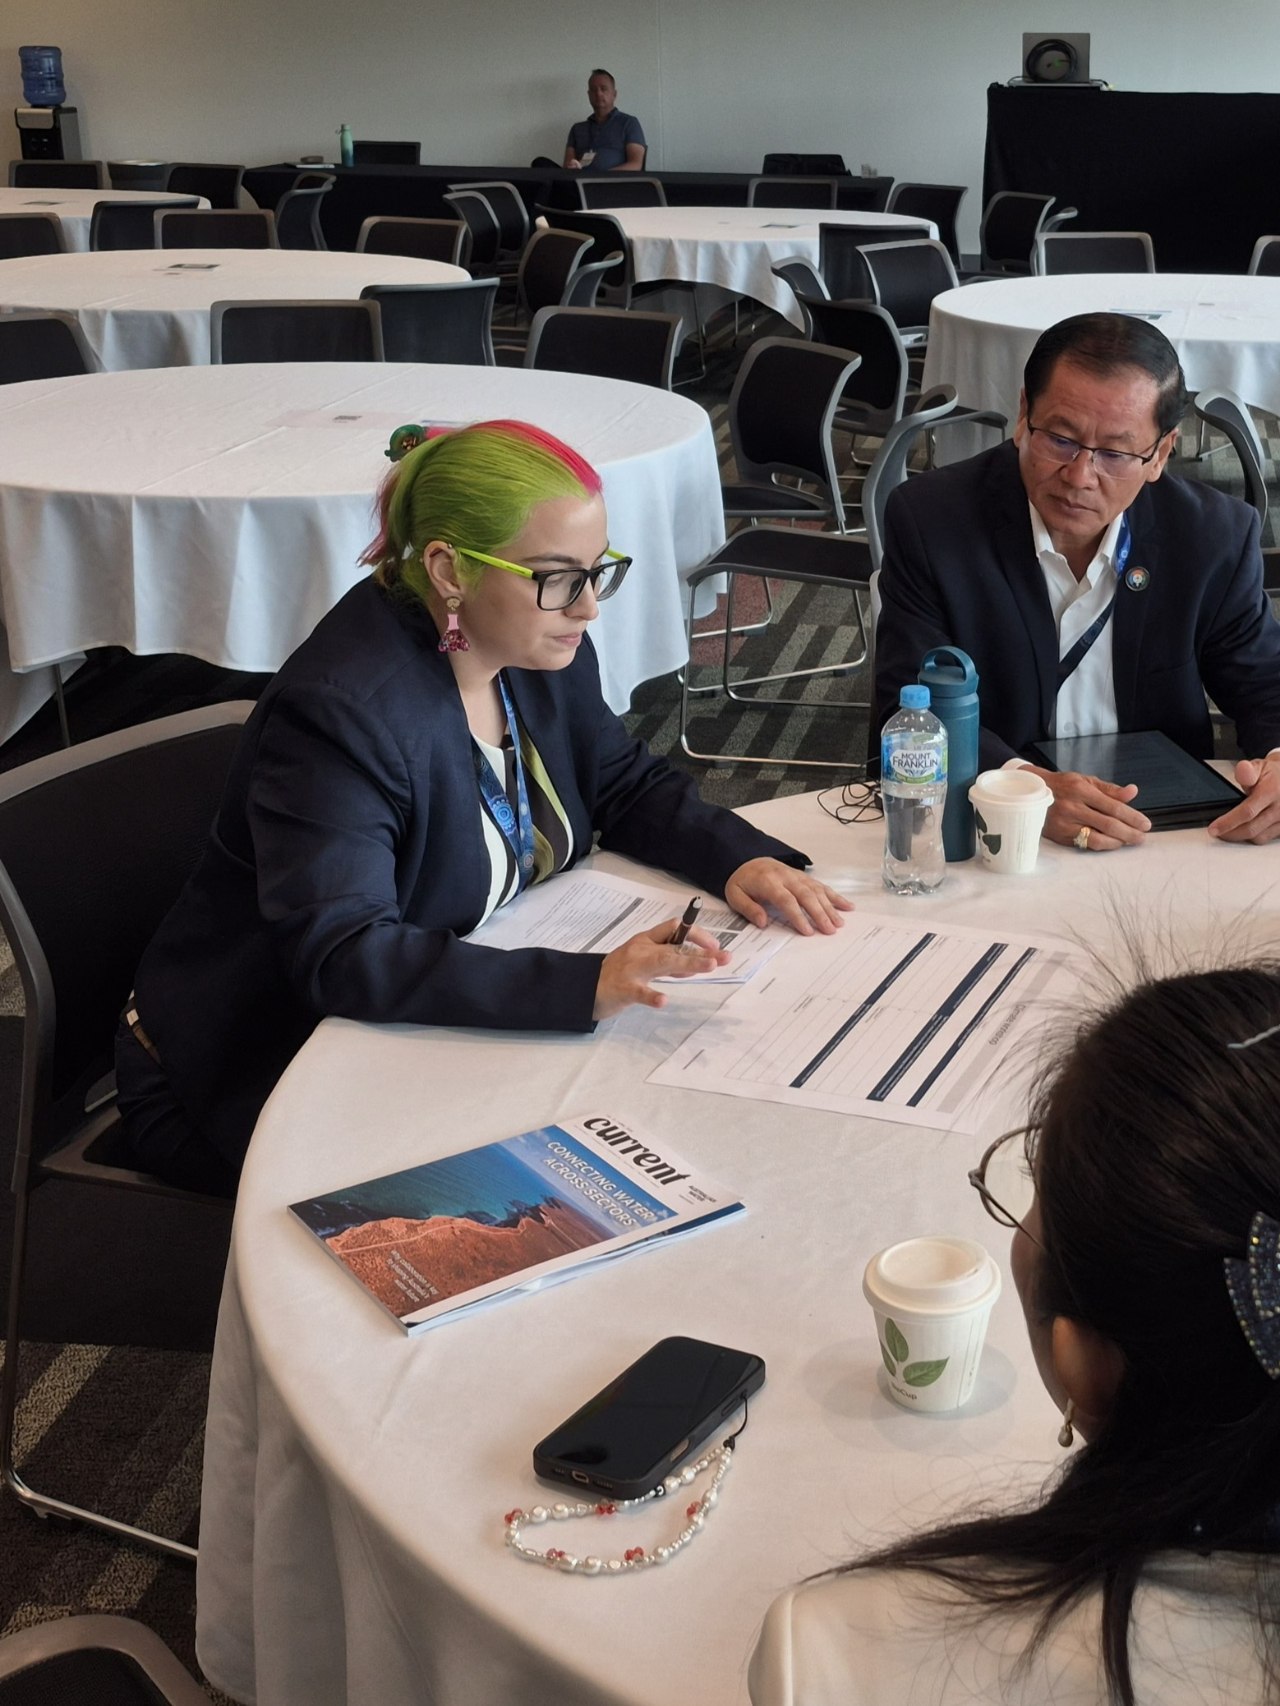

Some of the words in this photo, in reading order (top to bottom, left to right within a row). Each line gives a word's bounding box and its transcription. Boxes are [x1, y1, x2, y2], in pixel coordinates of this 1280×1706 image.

[892, 756, 938, 768] FRANKLIN
[901, 752, 931, 760] MOUNT
[547, 1142, 617, 1191] CONNECTING
[613, 1190, 653, 1221] WATER
[583, 1118, 691, 1185] current
[543, 1157, 587, 1189] ACROSS
[584, 1186, 638, 1226] SECTORS
